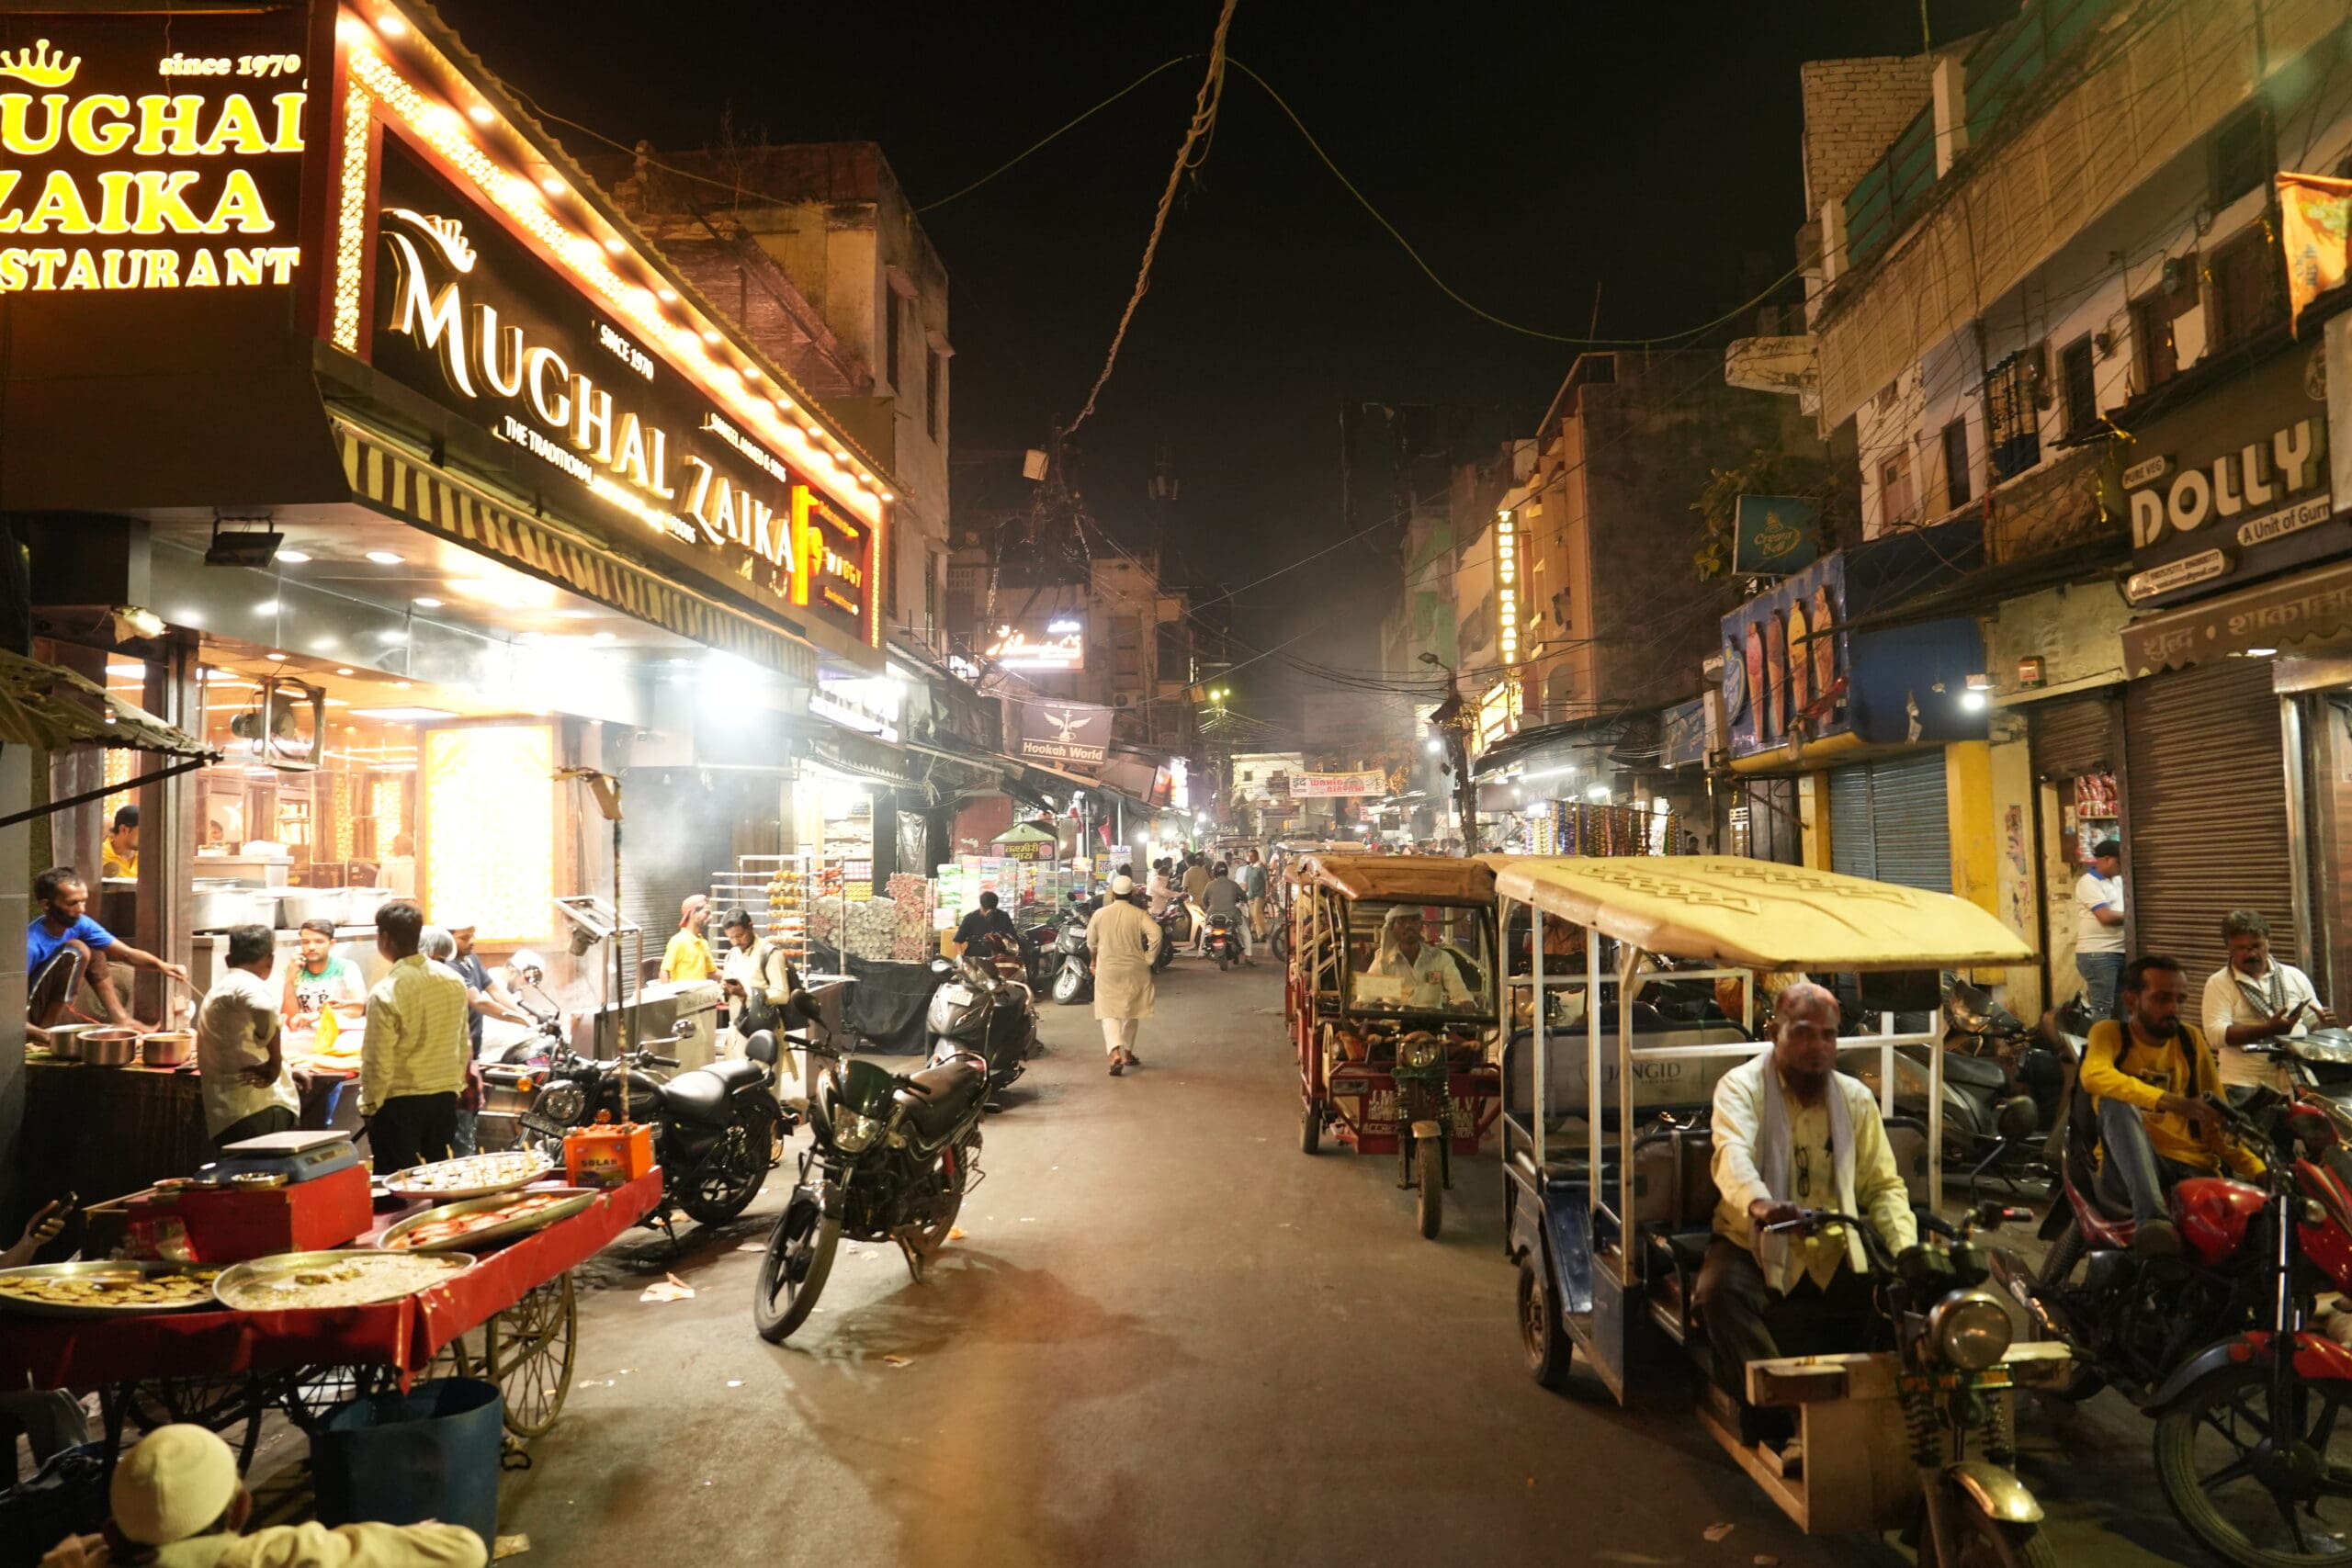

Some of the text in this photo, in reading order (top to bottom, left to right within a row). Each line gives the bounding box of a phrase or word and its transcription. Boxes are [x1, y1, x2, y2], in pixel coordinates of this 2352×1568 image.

[159, 53, 301, 77] since 1970
[0, 93, 307, 155] UGHA
[0, 247, 300, 292] STAURANT
[380, 231, 796, 573] MUGHAL ZAIKA
[504, 415, 528, 446] THE
[2131, 419, 2312, 548] DOLLY
[2144, 458, 2163, 477] VEG
[2244, 526, 2253, 543] A
[2254, 514, 2280, 539] Unit
[2282, 509, 2296, 529] of
[1023, 741, 1103, 761] Hookah World
[1608, 1062, 1682, 1084] JNGID
